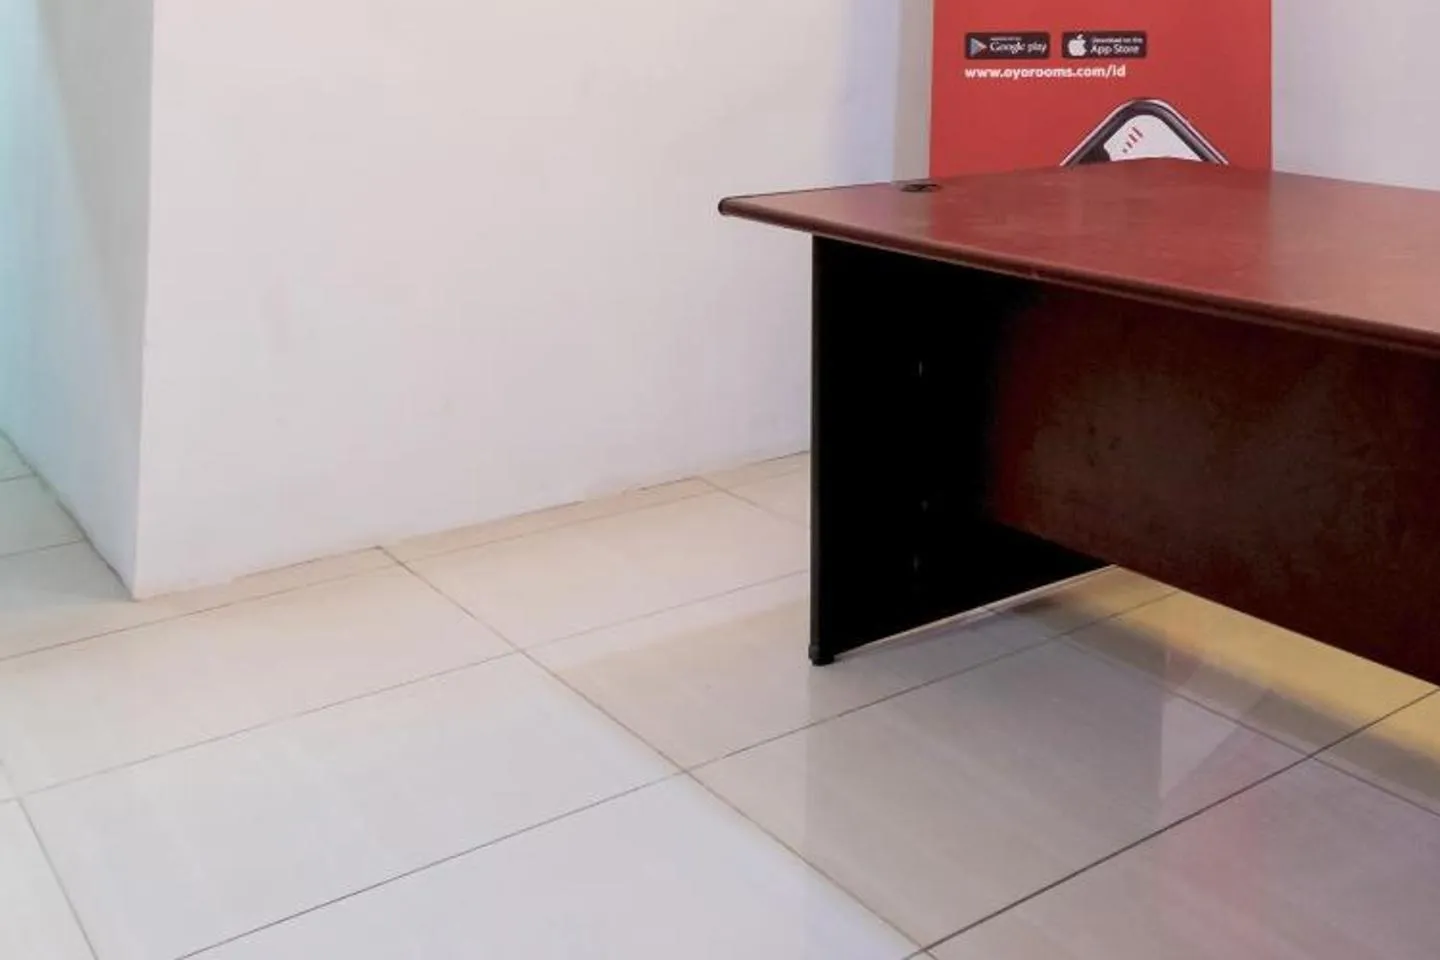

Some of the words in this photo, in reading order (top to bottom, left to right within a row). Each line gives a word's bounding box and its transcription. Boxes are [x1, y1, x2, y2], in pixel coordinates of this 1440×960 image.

[990, 41, 1025, 54] Google
[1027, 41, 1047, 54] play
[1090, 44, 1112, 55] App
[1113, 43, 1140, 54] Store
[964, 64, 1126, 80] www.oyorooms.com/id
